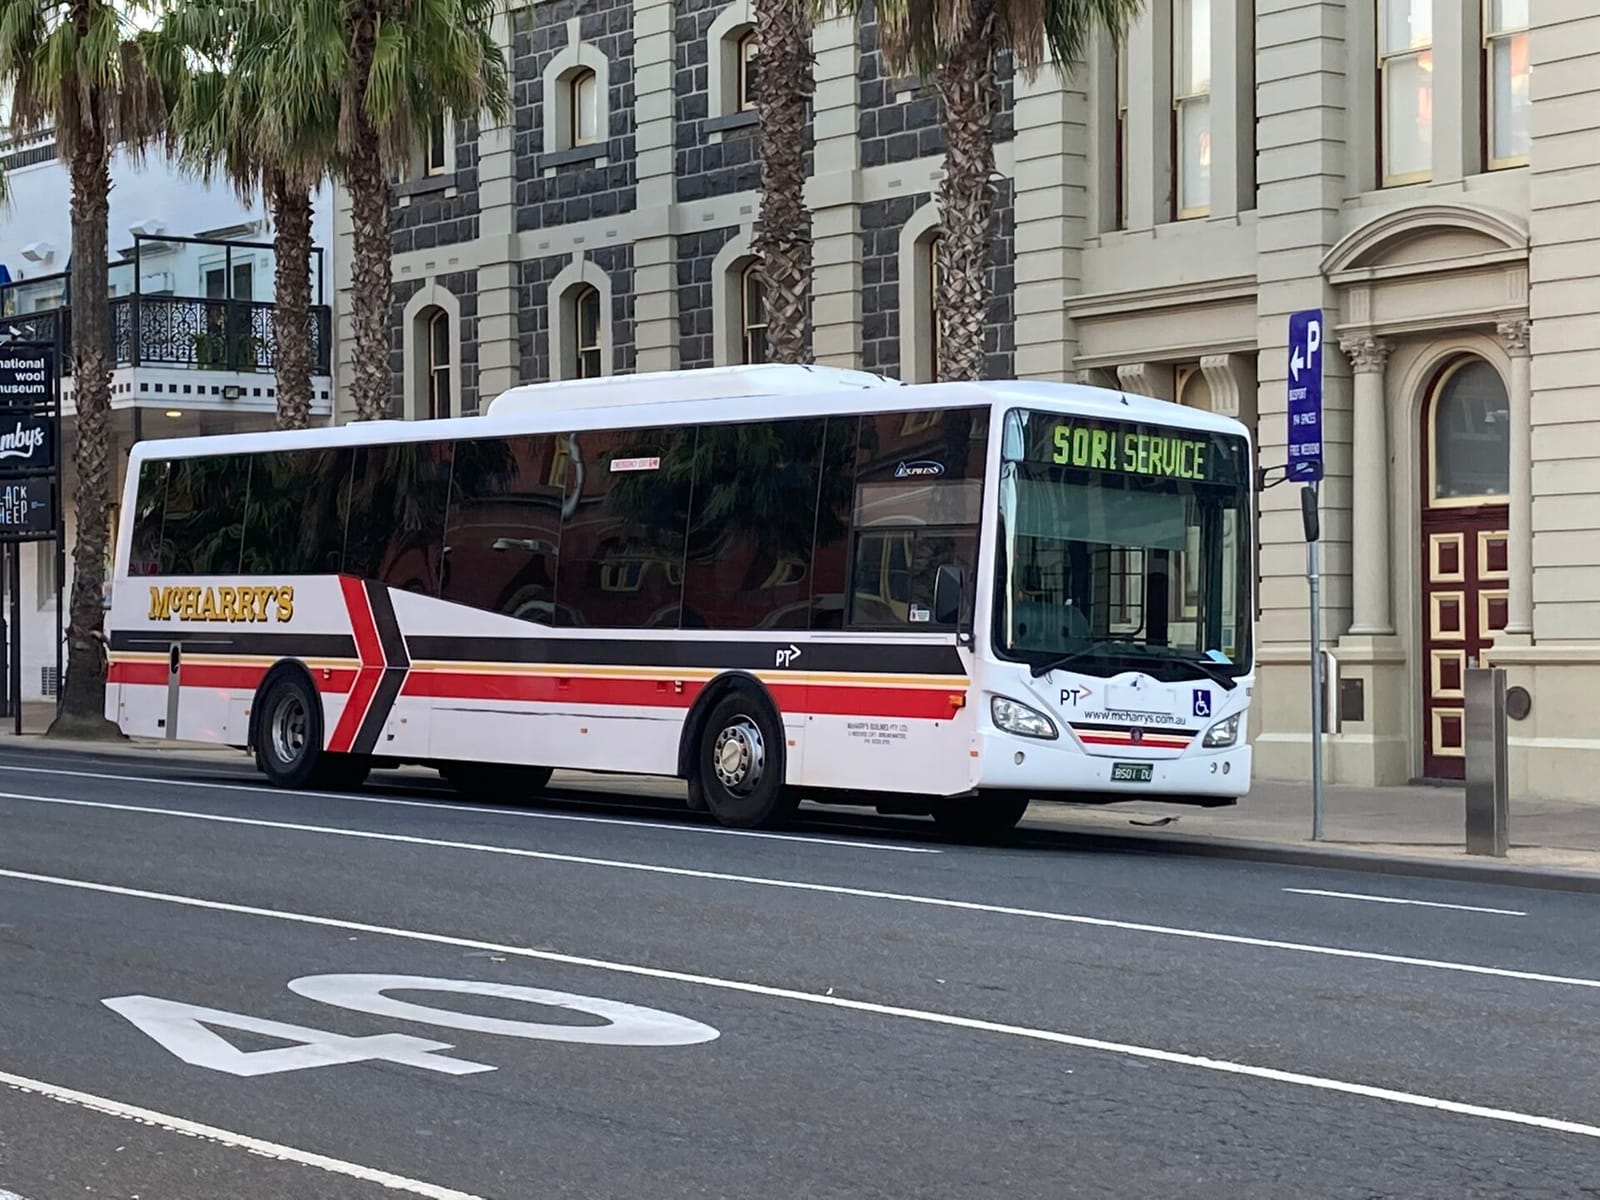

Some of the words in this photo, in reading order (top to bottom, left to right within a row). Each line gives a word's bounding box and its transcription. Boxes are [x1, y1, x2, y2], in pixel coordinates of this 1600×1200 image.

[1307, 320, 1320, 369] P
[14, 370, 45, 381] wool
[0, 421, 45, 459] mbys
[1123, 433, 1207, 480] SERVICE
[1083, 711, 1187, 726] www.mcharrys.com.au
[100, 973, 721, 1077] 40
